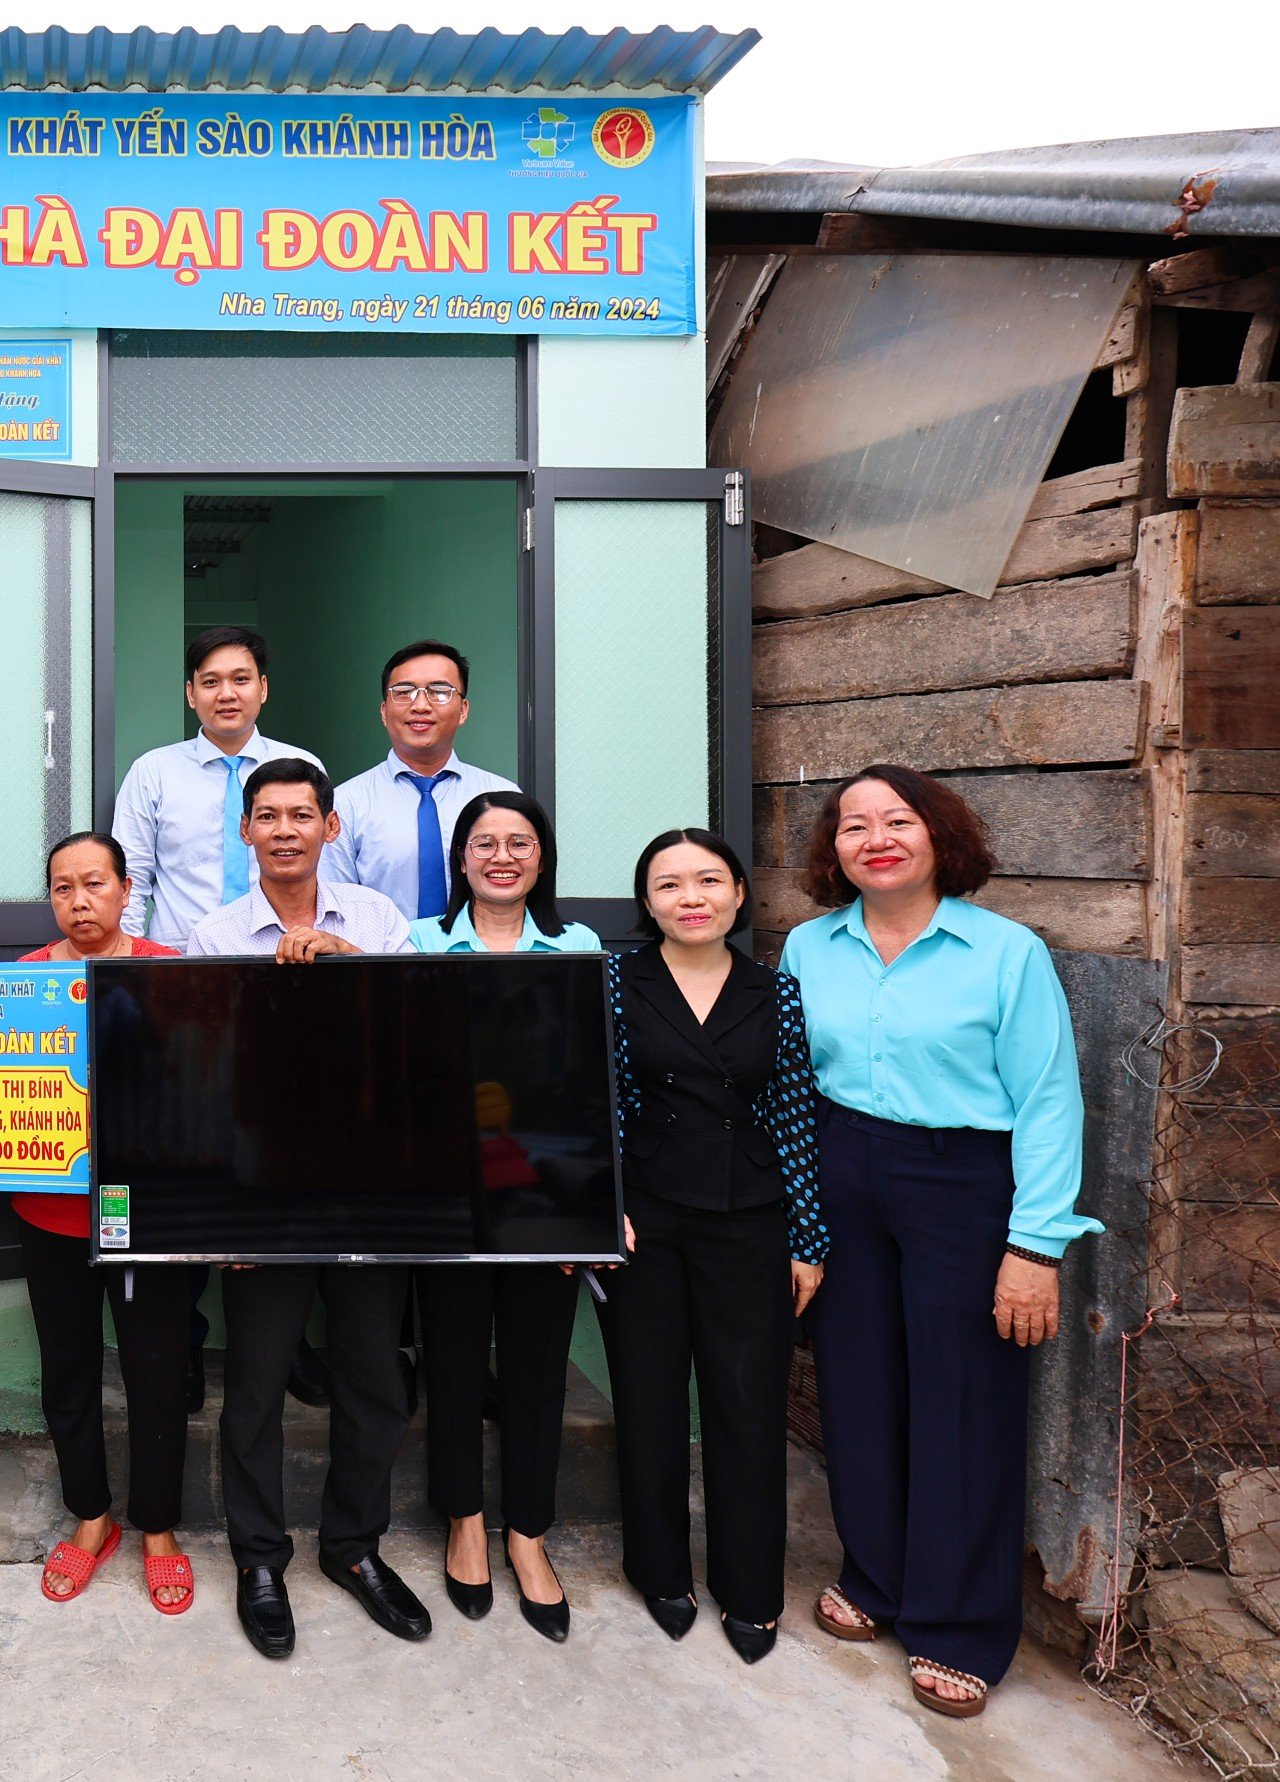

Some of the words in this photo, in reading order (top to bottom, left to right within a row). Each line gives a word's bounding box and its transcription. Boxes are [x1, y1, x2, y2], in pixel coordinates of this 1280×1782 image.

[8, 110, 106, 157] KHÁT
[115, 107, 189, 157] YẾN
[196, 112, 274, 158] SÀO
[283, 113, 412, 159] KHÁNH
[419, 113, 498, 160] HÒA
[98, 206, 243, 286] ĐẠI
[256, 198, 488, 274] ĐOÀN
[507, 195, 660, 276] KẾT
[219, 293, 265, 316] Nha
[272, 293, 343, 321] Trang,
[351, 295, 409, 323] ngày
[414, 295, 440, 318] 21
[446, 295, 512, 323] tháng
[517, 296, 545, 320] 06
[550, 297, 600, 320] năm
[606, 297, 660, 320] 2024
[32, 417, 60, 441] KẾT
[11, 980, 35, 997] KHÁT
[40, 1024, 77, 1054] KẾT
[2, 1080, 25, 1103] THỊ
[29, 1077, 62, 1099] BÍNH
[10, 1106, 53, 1131] KHÁNH
[56, 1106, 82, 1132] HÒA
[16, 1135, 65, 1161] ĐỒNG
